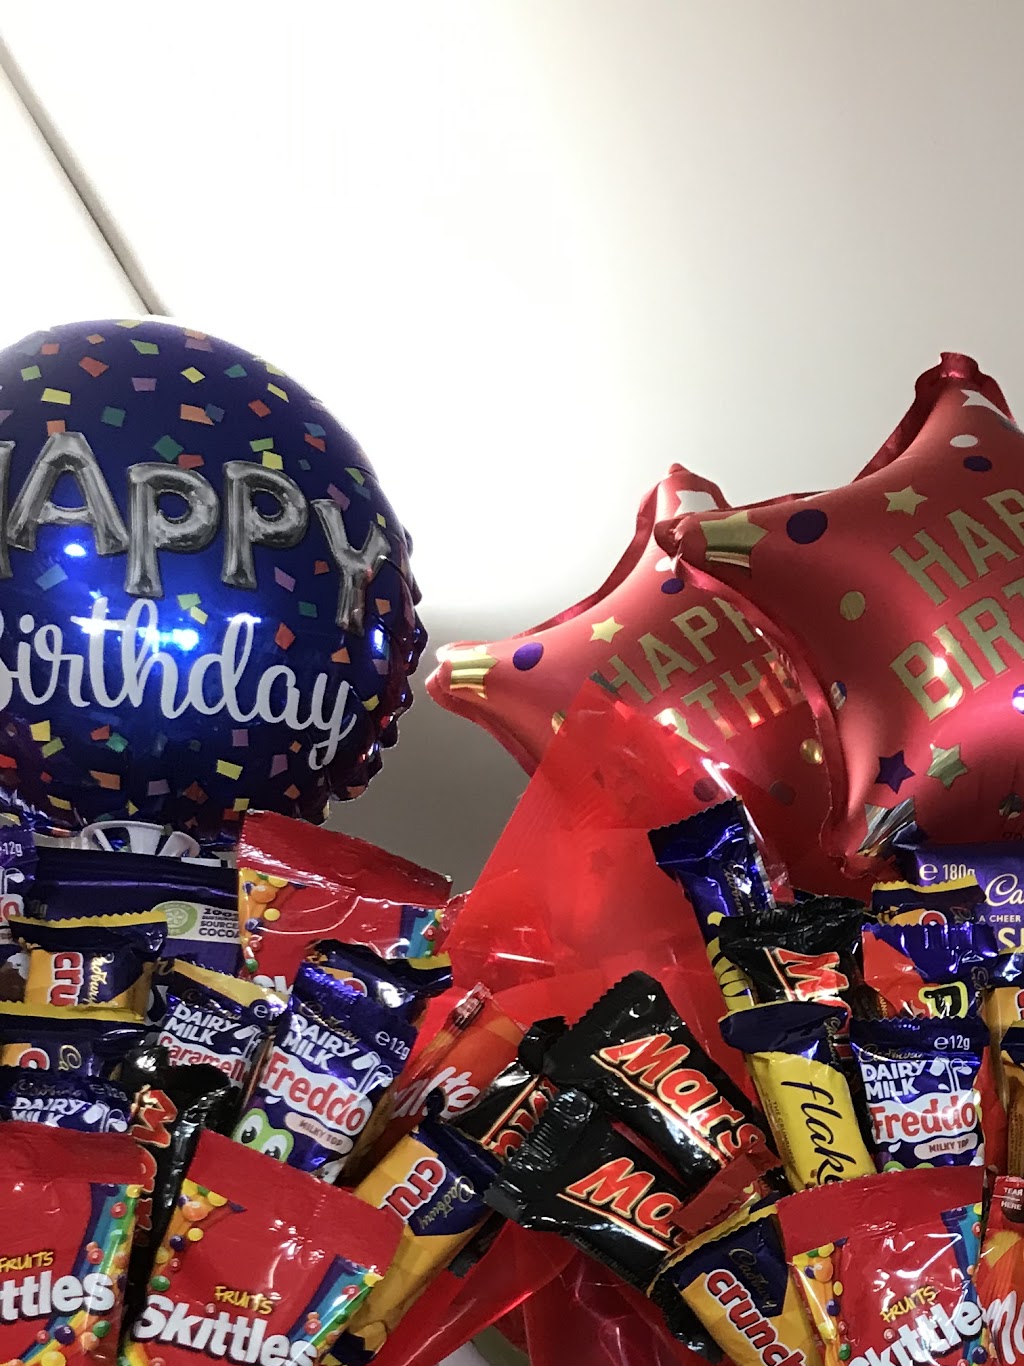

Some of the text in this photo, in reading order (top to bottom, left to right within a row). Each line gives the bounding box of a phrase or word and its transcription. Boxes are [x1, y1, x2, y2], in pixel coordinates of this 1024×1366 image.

[0, 432, 391, 635] APPY
[989, 915, 1023, 923] CHEER
[164, 1018, 220, 1046] MILK
[173, 1003, 241, 1033] DAIRY
[281, 1032, 331, 1070] MILK
[289, 1014, 358, 1061] DAIRY
[861, 1061, 926, 1082] DAIRY
[264, 1050, 366, 1132] Freddo
[599, 1033, 766, 1161] Mars
[864, 1077, 921, 1101] MILK
[15, 1097, 90, 1115] DAIRY
[870, 1095, 976, 1141] Freddo
[1001, 1201, 1022, 1211] HERE
[216, 1286, 273, 1315] FRUITS
[880, 1286, 938, 1323] FRUITS
